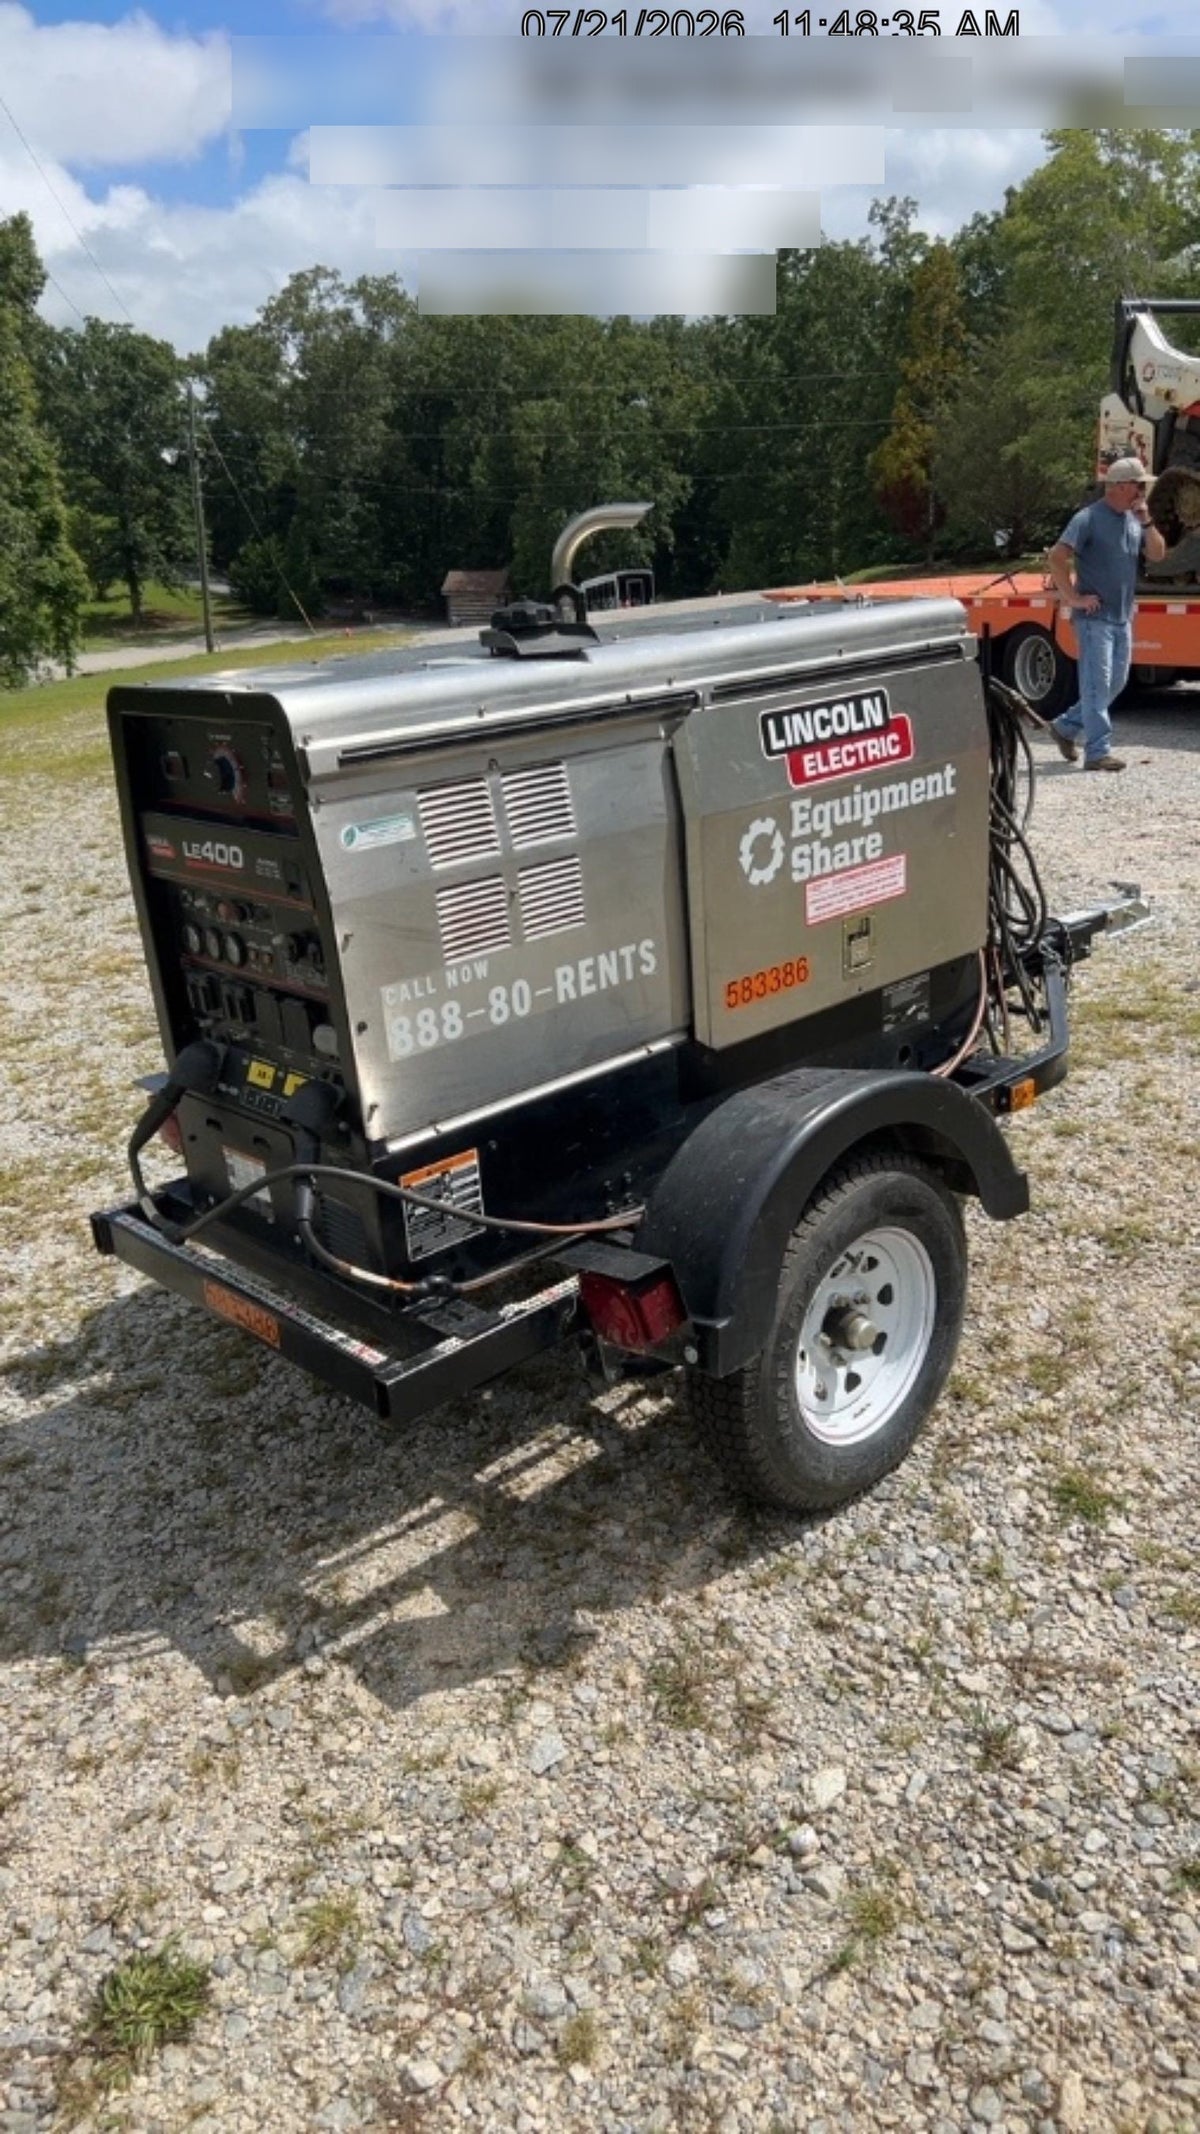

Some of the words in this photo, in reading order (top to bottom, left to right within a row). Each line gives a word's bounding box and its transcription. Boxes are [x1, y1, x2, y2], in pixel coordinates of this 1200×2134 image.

[767, 696, 885, 751] LINCOLN
[803, 732, 901, 778] ELECTRIC
[790, 763, 957, 839] Equipment
[182, 840, 245, 869] LE400
[791, 831, 884, 883] Share
[384, 975, 437, 1006] CALL
[445, 959, 490, 989] NOW
[390, 938, 658, 1058] 888-80-RENTS
[727, 956, 809, 1008] 583386
